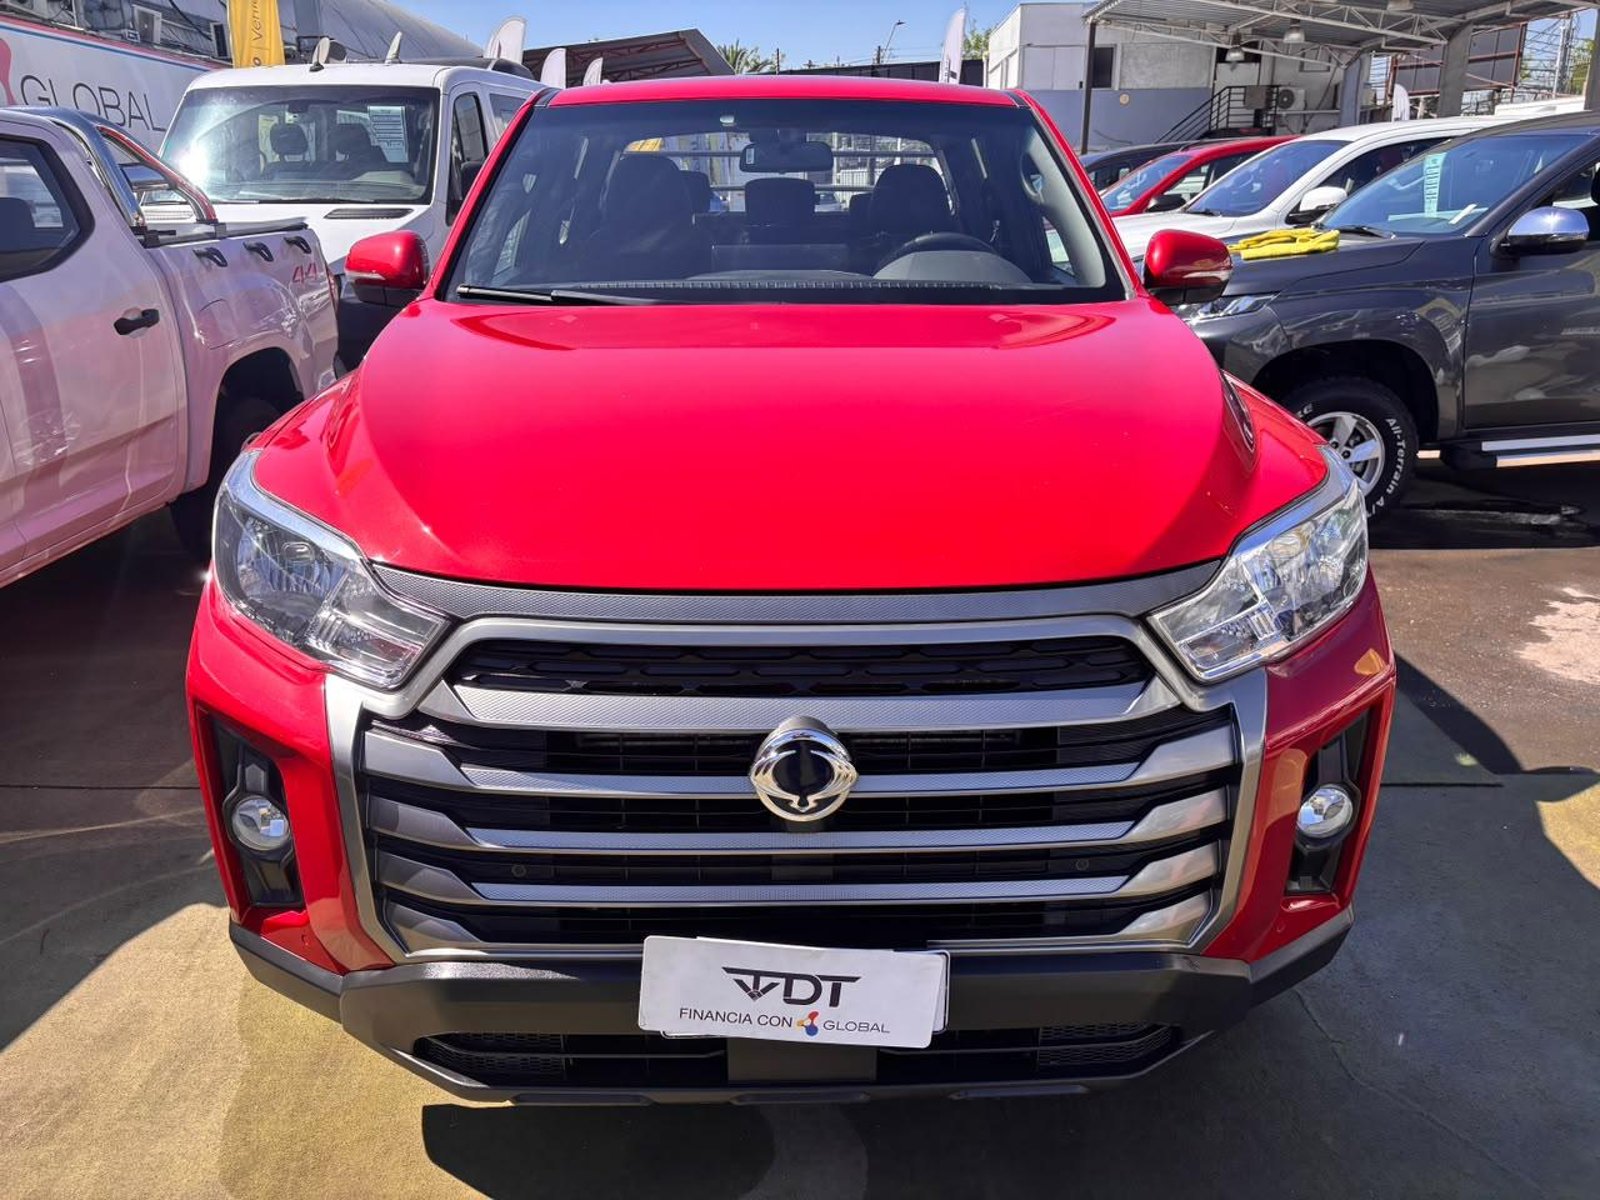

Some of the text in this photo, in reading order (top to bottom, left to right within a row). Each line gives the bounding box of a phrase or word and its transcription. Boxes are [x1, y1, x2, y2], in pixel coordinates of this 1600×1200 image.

[20, 74, 168, 132] GLOBAL
[1385, 417, 1406, 495] All-Terrain
[679, 1007, 891, 1034] FINANCIA CON GLOBAL
